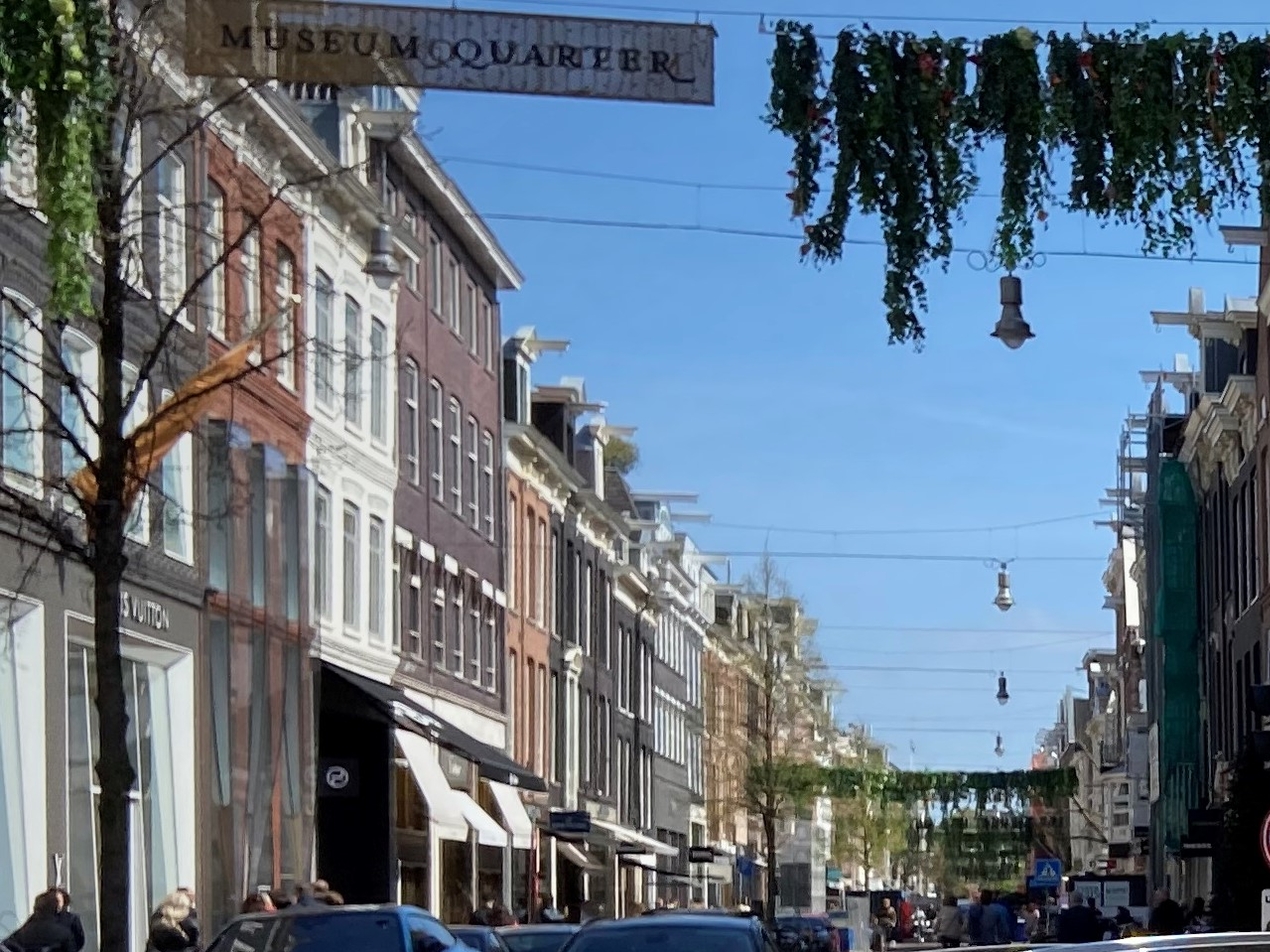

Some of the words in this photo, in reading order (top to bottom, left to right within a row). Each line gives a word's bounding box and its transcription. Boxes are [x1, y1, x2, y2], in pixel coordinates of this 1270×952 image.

[220, 23, 420, 59] MUSEUM
[454, 37, 696, 83] QUARTER
[131, 596, 169, 629] VUITTON
